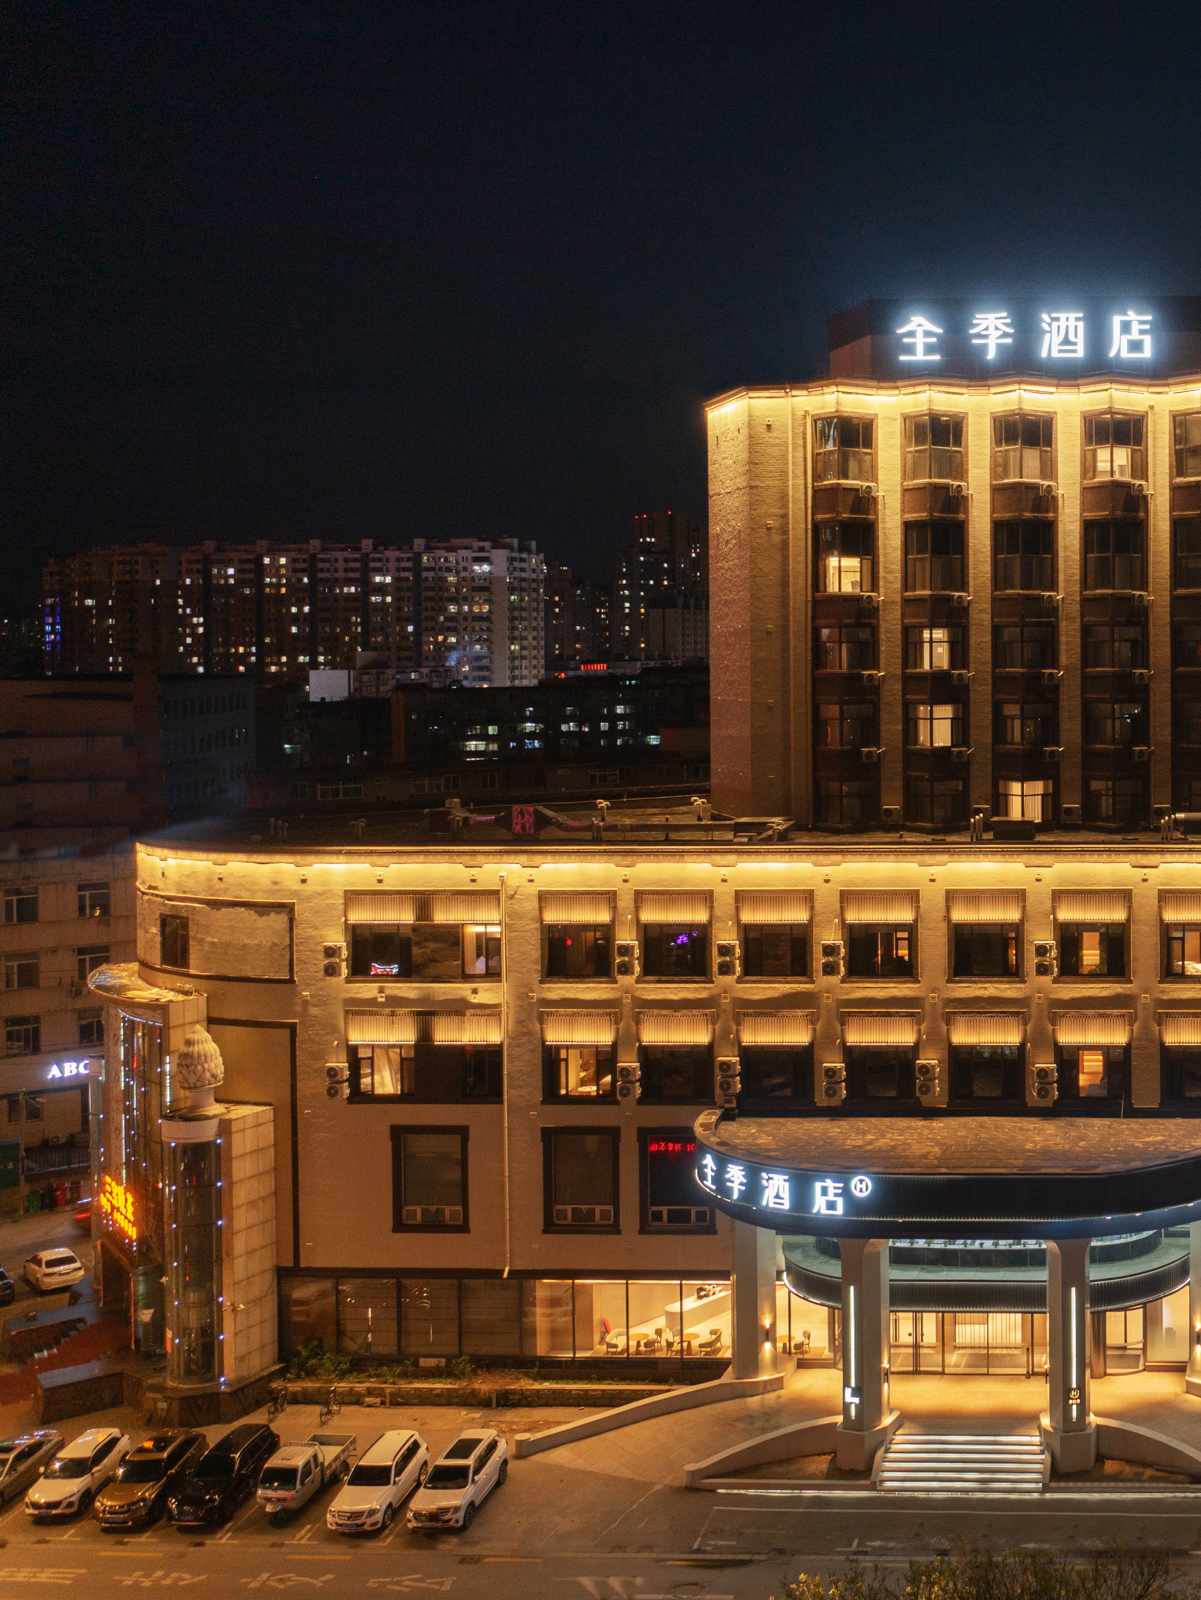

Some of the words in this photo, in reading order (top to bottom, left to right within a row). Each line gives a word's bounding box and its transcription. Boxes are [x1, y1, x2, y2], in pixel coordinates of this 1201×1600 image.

[896, 310, 1154, 361] 全季酒店
[702, 1153, 844, 1216] 全季酒店
